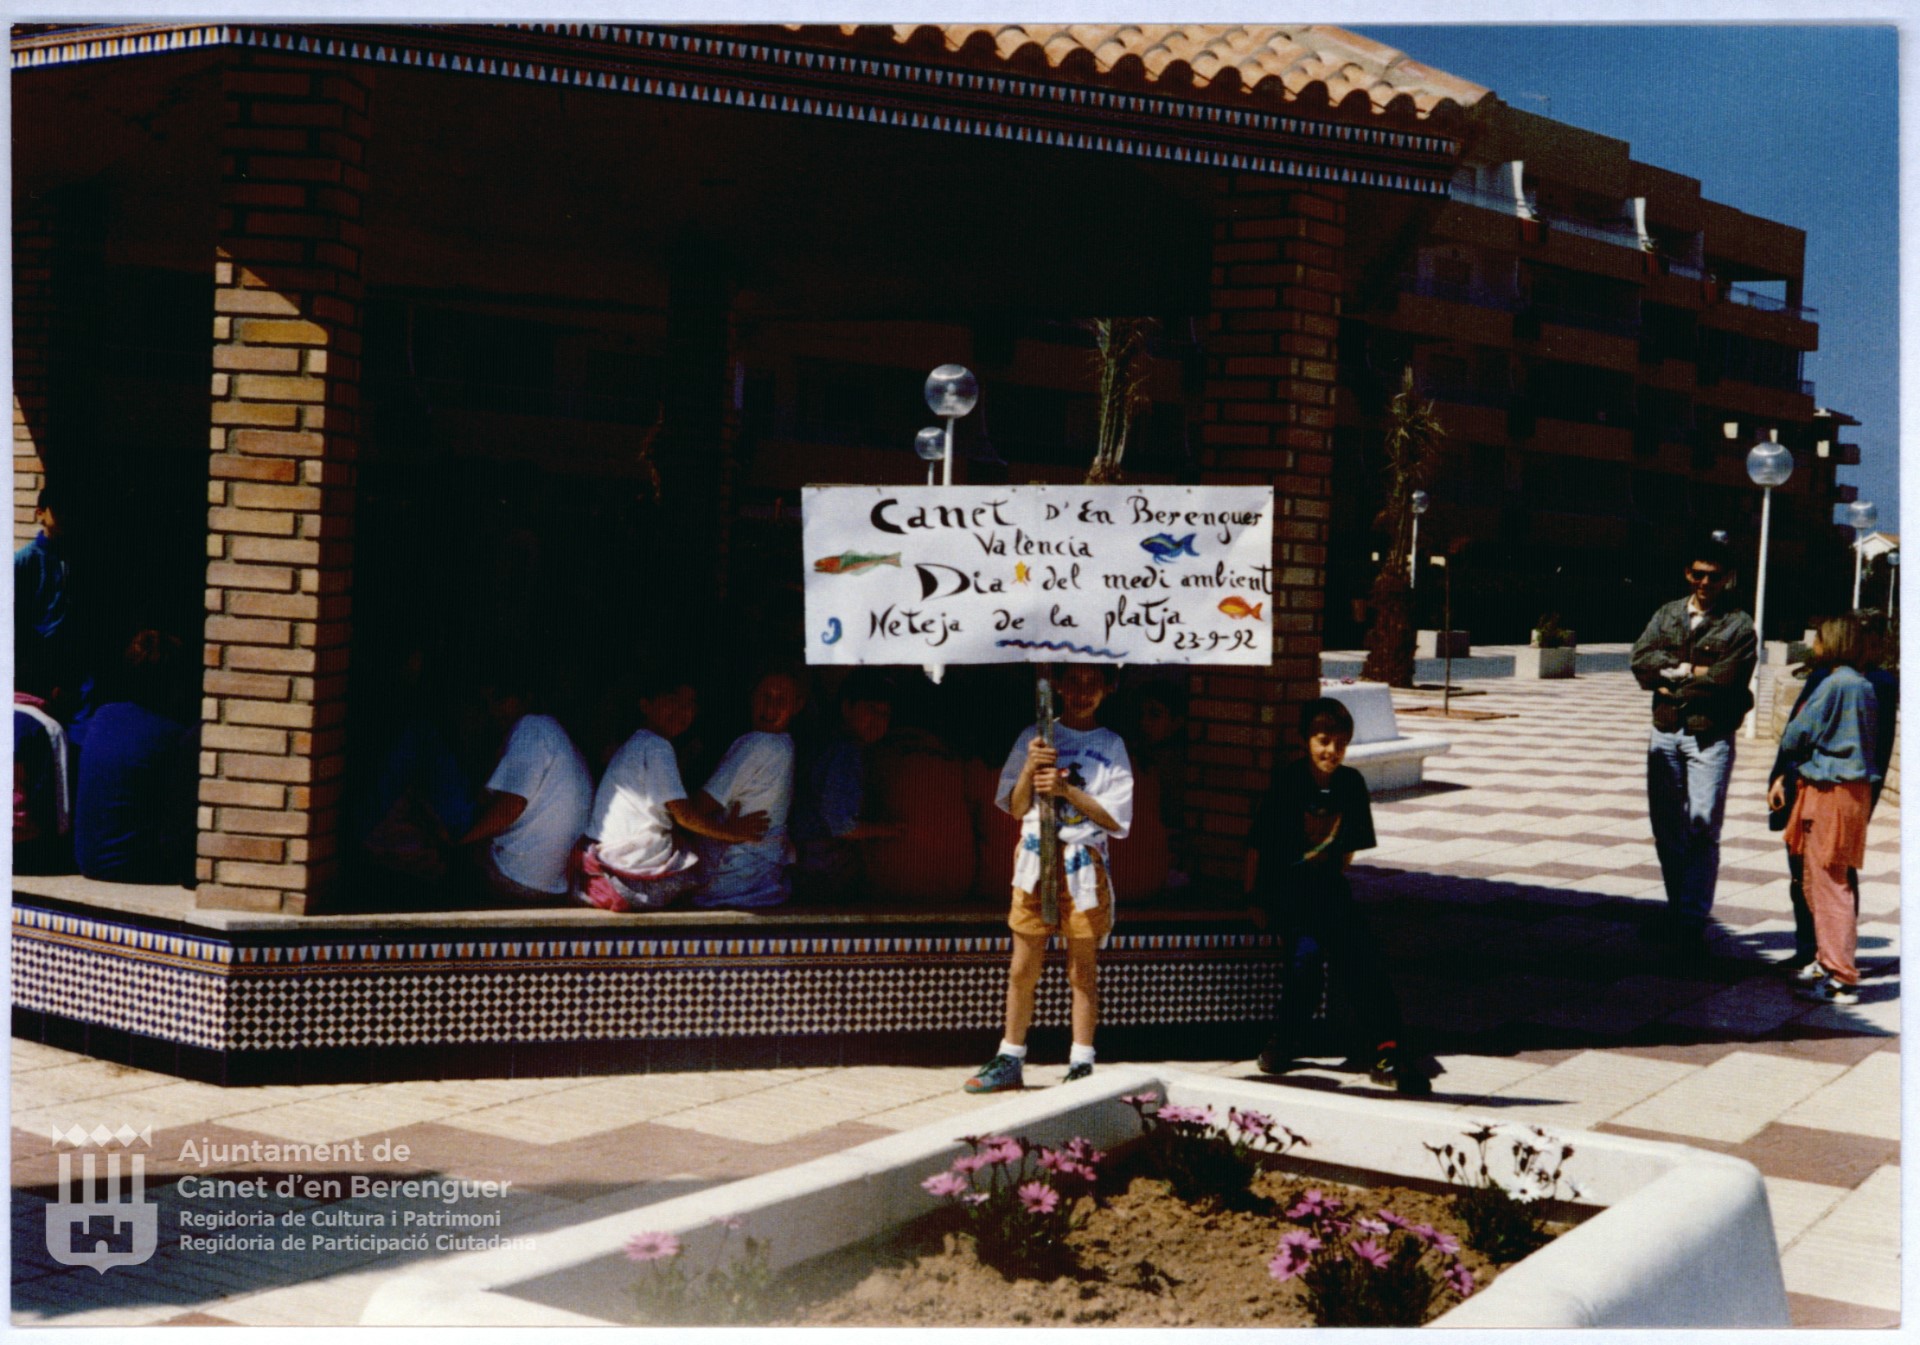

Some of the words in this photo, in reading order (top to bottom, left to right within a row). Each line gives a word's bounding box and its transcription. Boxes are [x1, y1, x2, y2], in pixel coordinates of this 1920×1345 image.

[870, 498, 1016, 535] Canet
[1127, 495, 1263, 545] Berenguer
[914, 562, 1007, 601] Dia
[1042, 562, 1082, 591] del
[1102, 565, 1171, 589] medi
[1180, 560, 1273, 595] ambient
[868, 603, 963, 647] Neteja
[992, 609, 1025, 632] de
[1049, 603, 1079, 628] la
[1104, 594, 1186, 644] platja
[1173, 629, 1258, 651] 23-9-92
